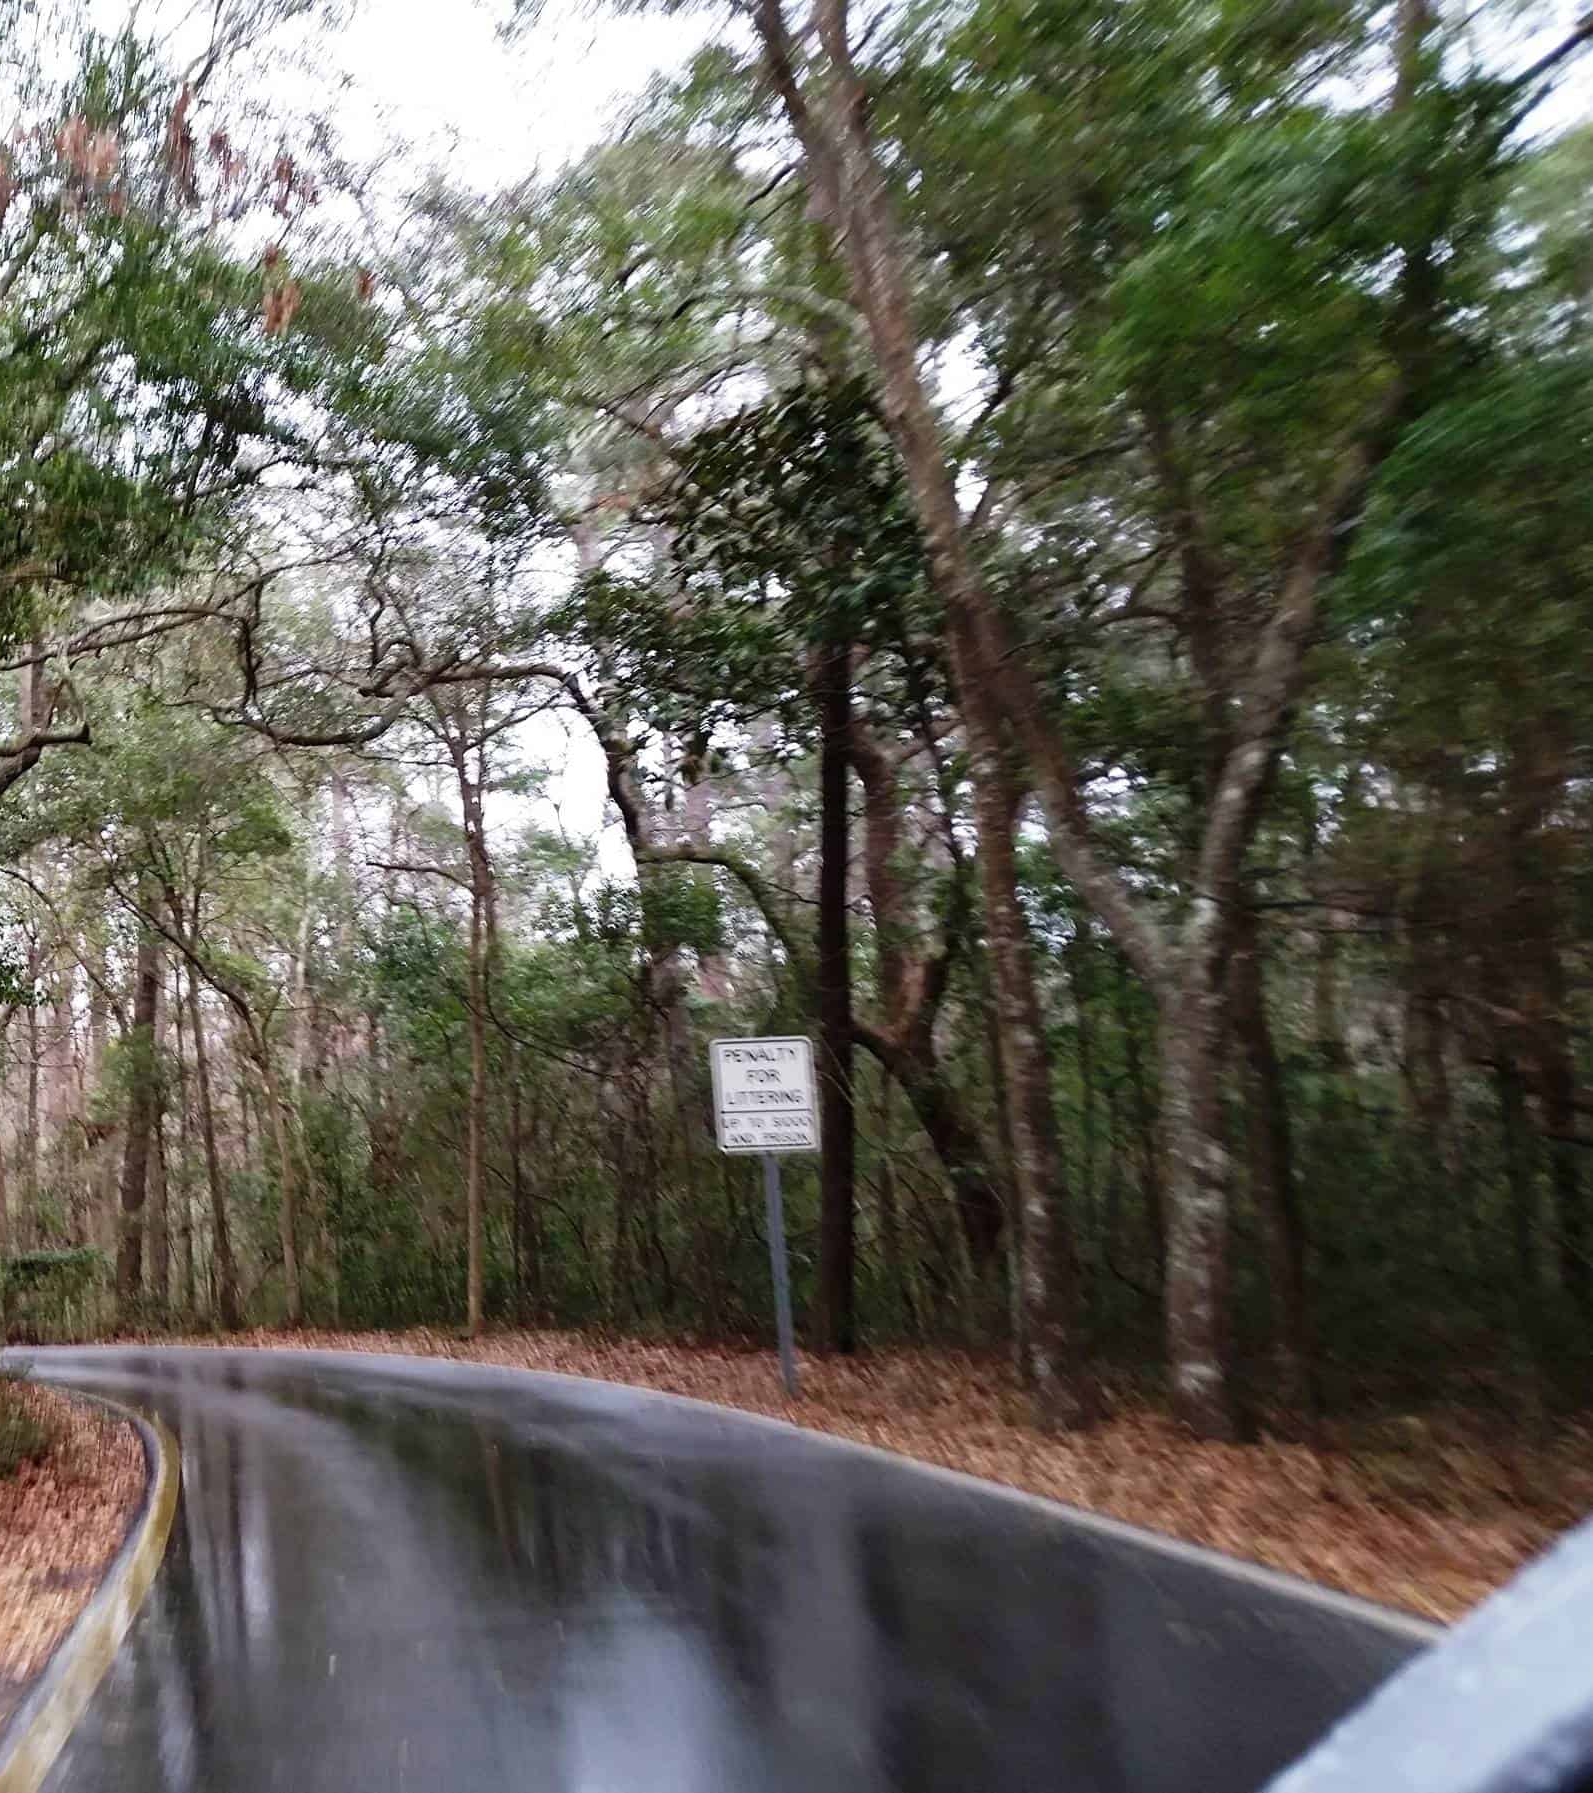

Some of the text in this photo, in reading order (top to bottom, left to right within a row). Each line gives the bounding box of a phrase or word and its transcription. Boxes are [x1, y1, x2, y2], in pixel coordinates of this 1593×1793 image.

[722, 1047, 797, 1063] PENALTY
[746, 1069, 782, 1084] FOR
[725, 1089, 805, 1106] LITTERING
